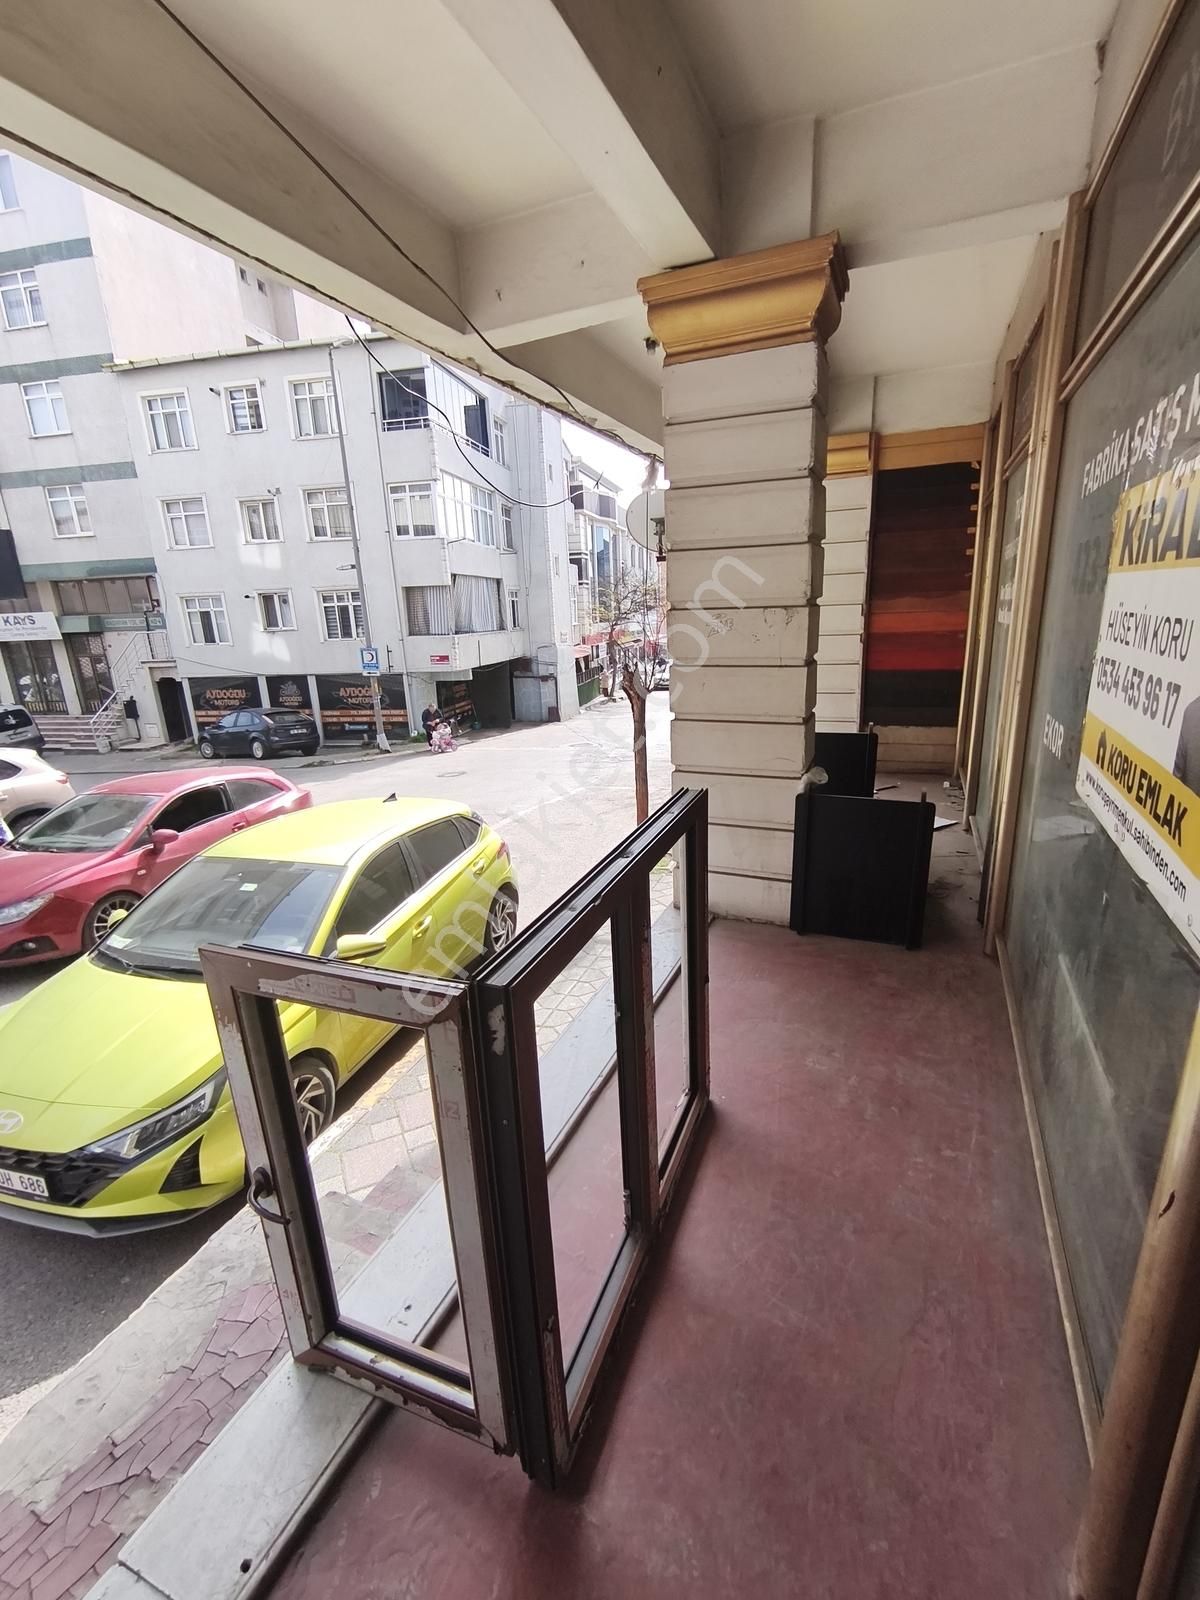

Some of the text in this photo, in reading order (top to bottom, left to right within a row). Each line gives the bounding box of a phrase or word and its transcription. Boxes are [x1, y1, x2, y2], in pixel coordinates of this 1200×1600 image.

[1, 614, 36, 627] KAYS
[1106, 602, 1194, 662] HÜSEYİN KORU
[206, 688, 246, 699] AYDOĞDU
[1097, 656, 1182, 730] 0534 453 96 17
[1106, 743, 1189, 848] KORU EMLAK
[19, 1175, 45, 1194] 686
